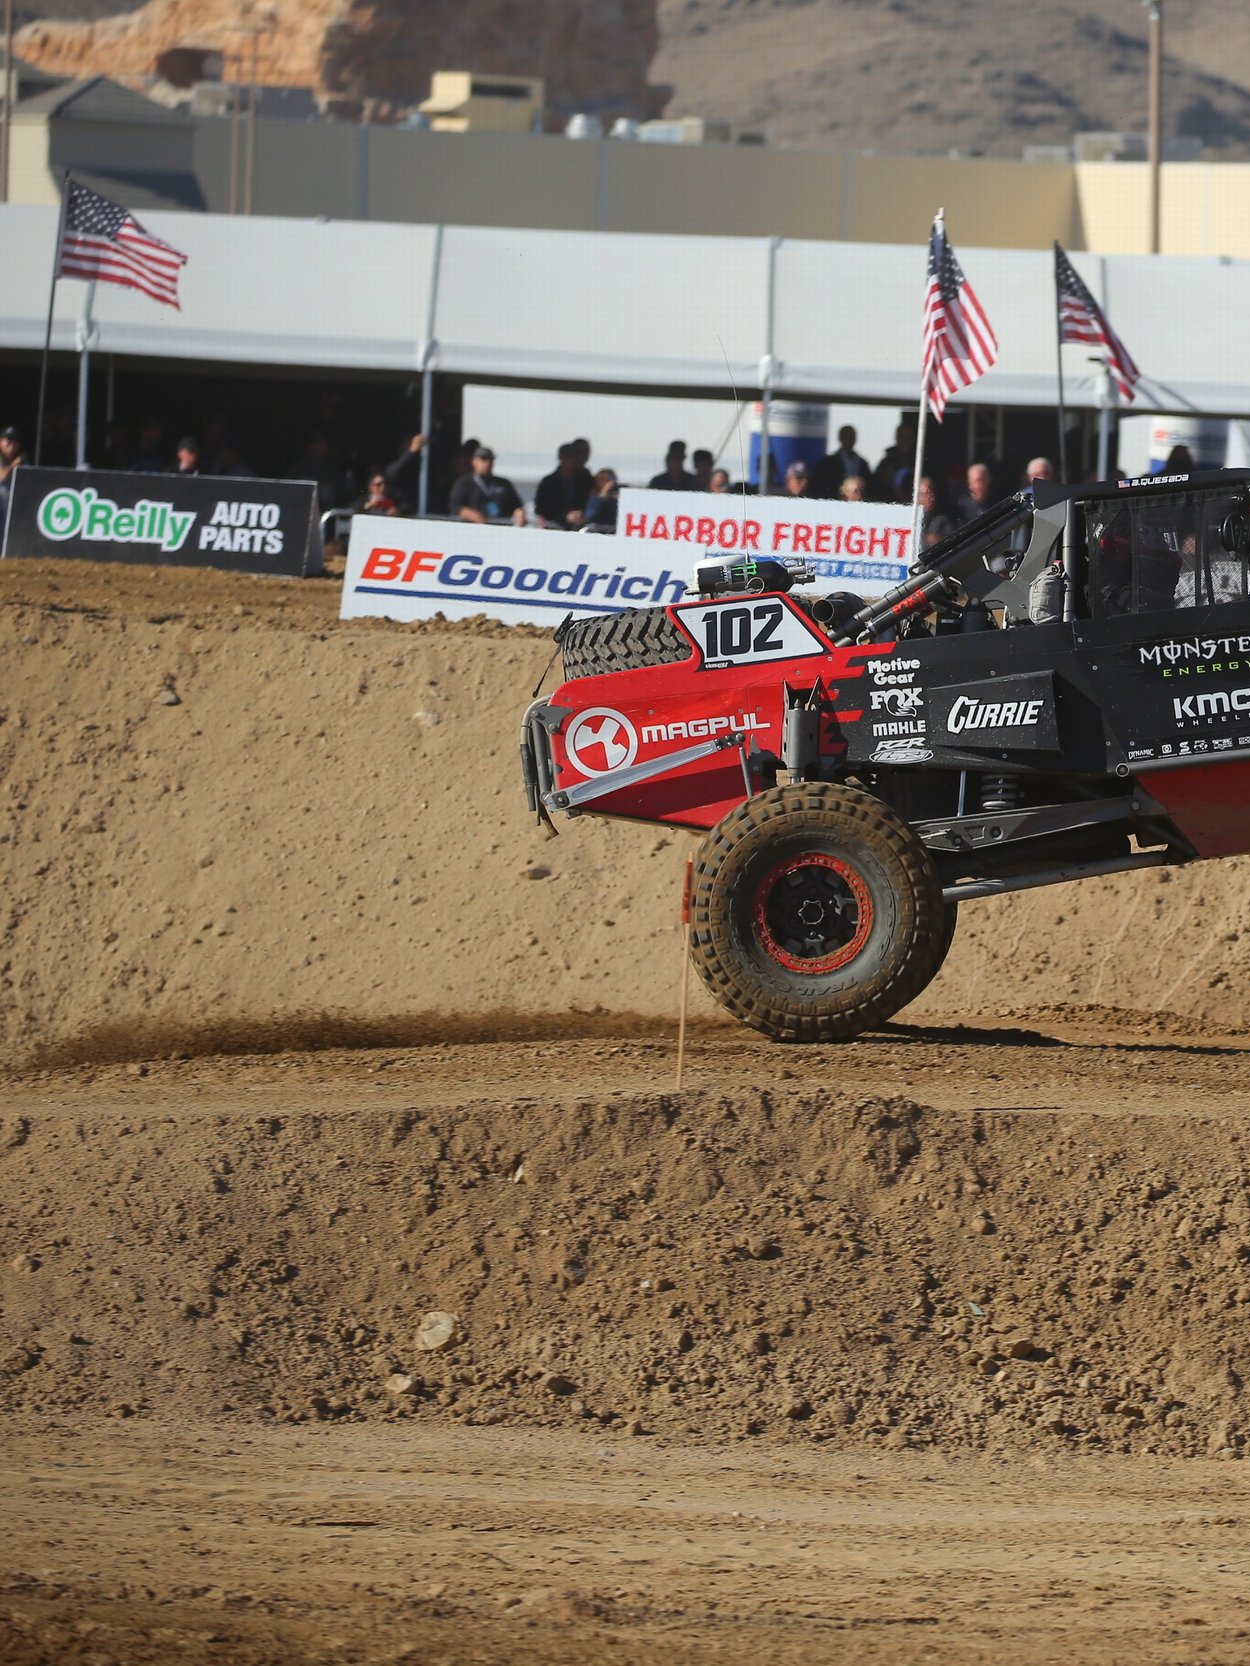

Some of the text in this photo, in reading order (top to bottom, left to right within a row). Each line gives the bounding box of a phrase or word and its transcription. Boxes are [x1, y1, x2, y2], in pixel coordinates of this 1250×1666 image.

[37, 486, 197, 552] O'Reilly
[210, 500, 281, 530] AUTO
[198, 525, 284, 555] PARTS
[625, 513, 911, 559] HARBOR FREIGHT
[360, 547, 687, 604] BFGoodrich
[701, 603, 784, 658] 102
[867, 657, 921, 674] Motive
[873, 672, 915, 685] Gear
[870, 687, 924, 717] FOX
[947, 695, 1044, 734] CURRIE
[641, 713, 770, 743] MAGPUL
[872, 720, 926, 737] MAHLE
[875, 737, 926, 753] RZR
[1128, 748, 1155, 760] DYNAMIC
